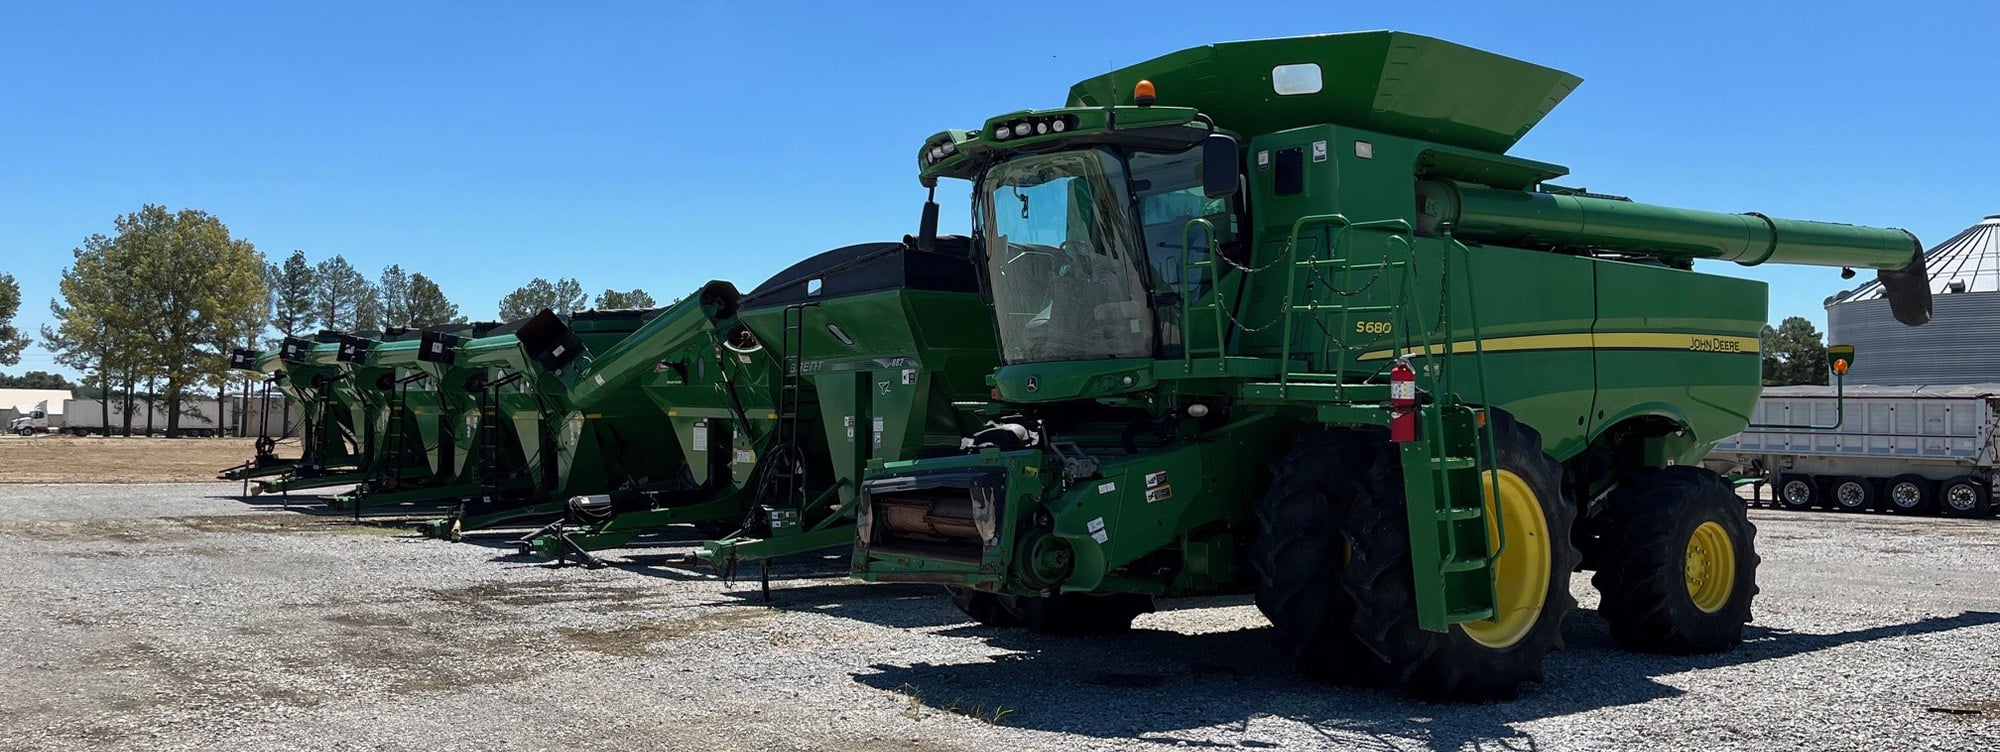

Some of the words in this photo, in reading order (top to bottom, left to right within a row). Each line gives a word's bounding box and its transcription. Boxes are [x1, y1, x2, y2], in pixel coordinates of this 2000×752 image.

[1355, 321, 1392, 334] S680
[1689, 337, 1712, 351] JOHN
[1713, 338, 1740, 352] DEERE
